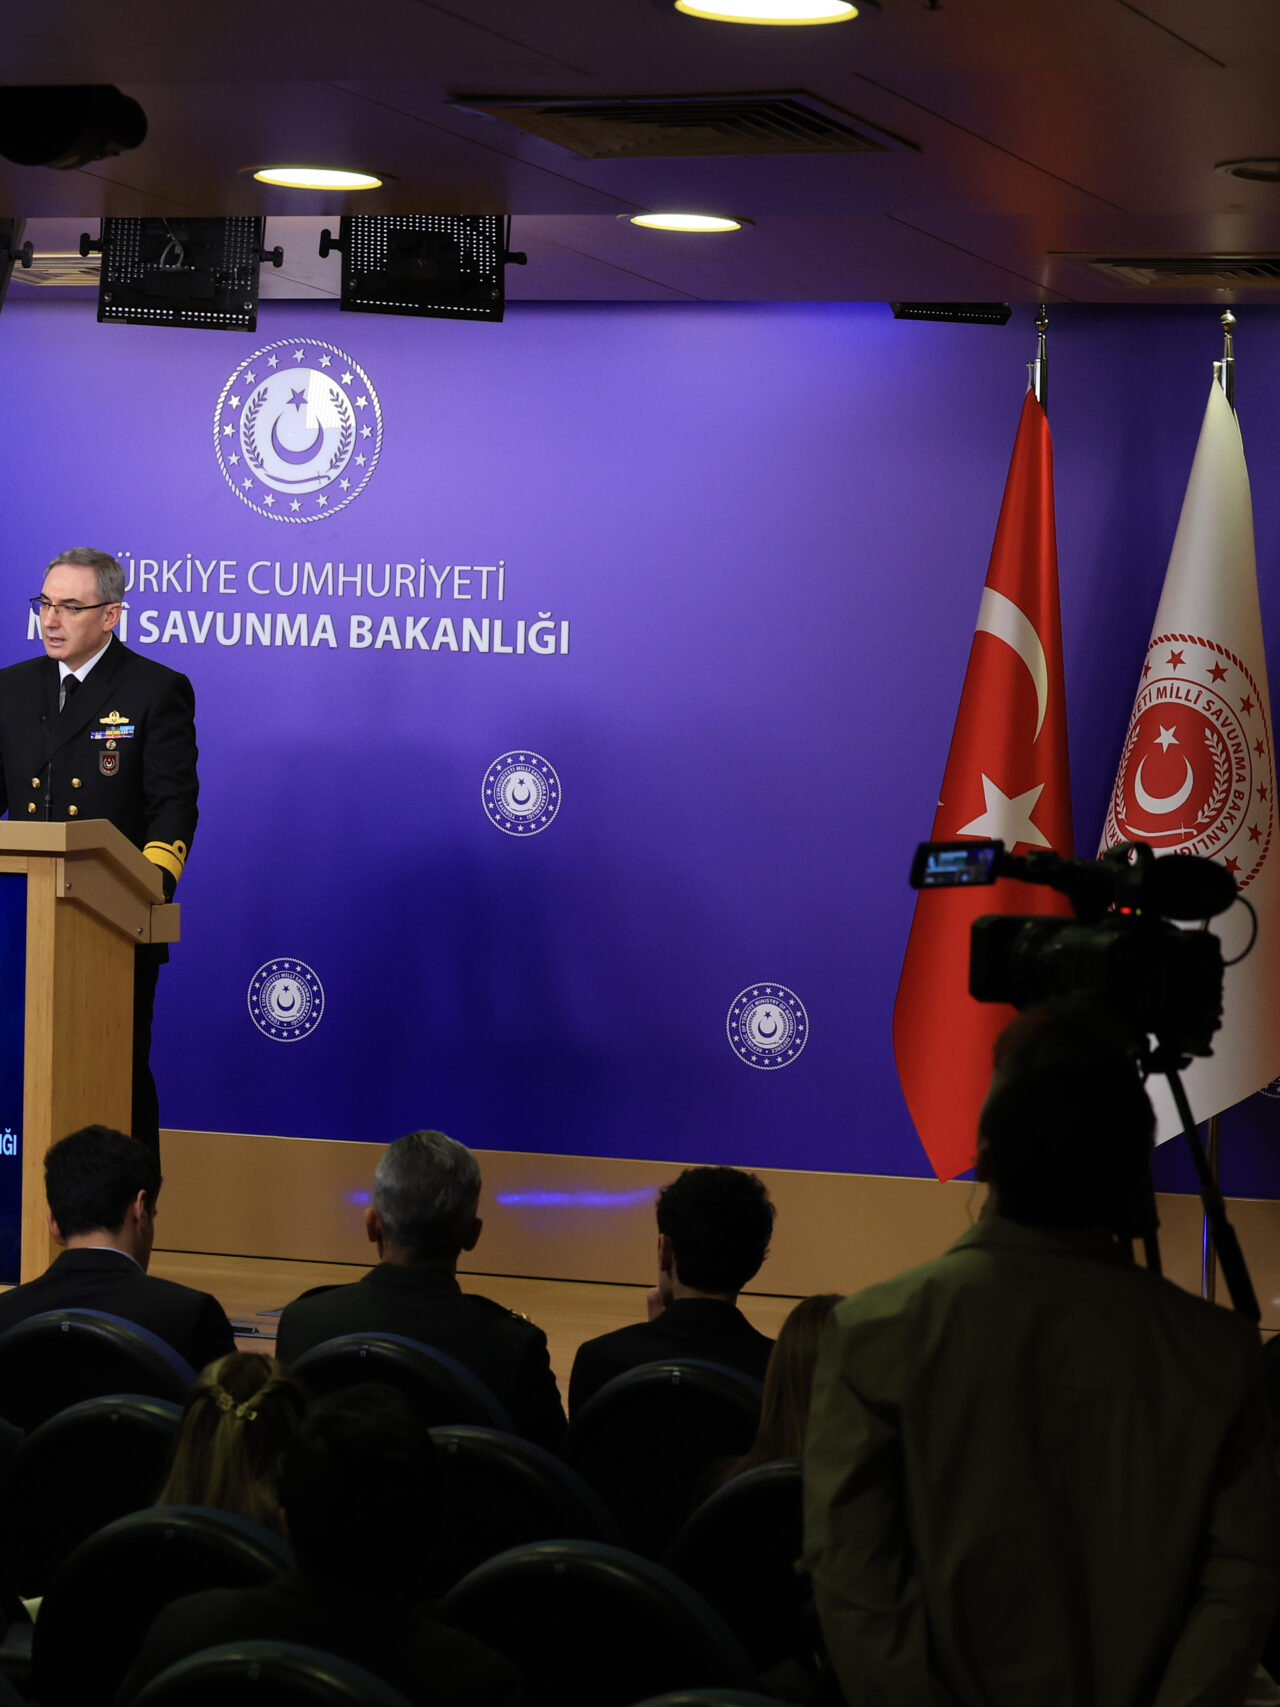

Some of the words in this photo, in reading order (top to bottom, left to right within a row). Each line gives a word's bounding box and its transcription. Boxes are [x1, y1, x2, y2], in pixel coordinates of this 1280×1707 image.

[116, 551, 237, 594] ÜRKİYE
[247, 559, 506, 601] CUMHURİYETİ
[139, 609, 338, 649] SAVUNMA
[348, 611, 571, 656] BAKANLIĞI
[1156, 683, 1203, 705] MİLLÎ
[1202, 699, 1246, 784] SAVUNMA
